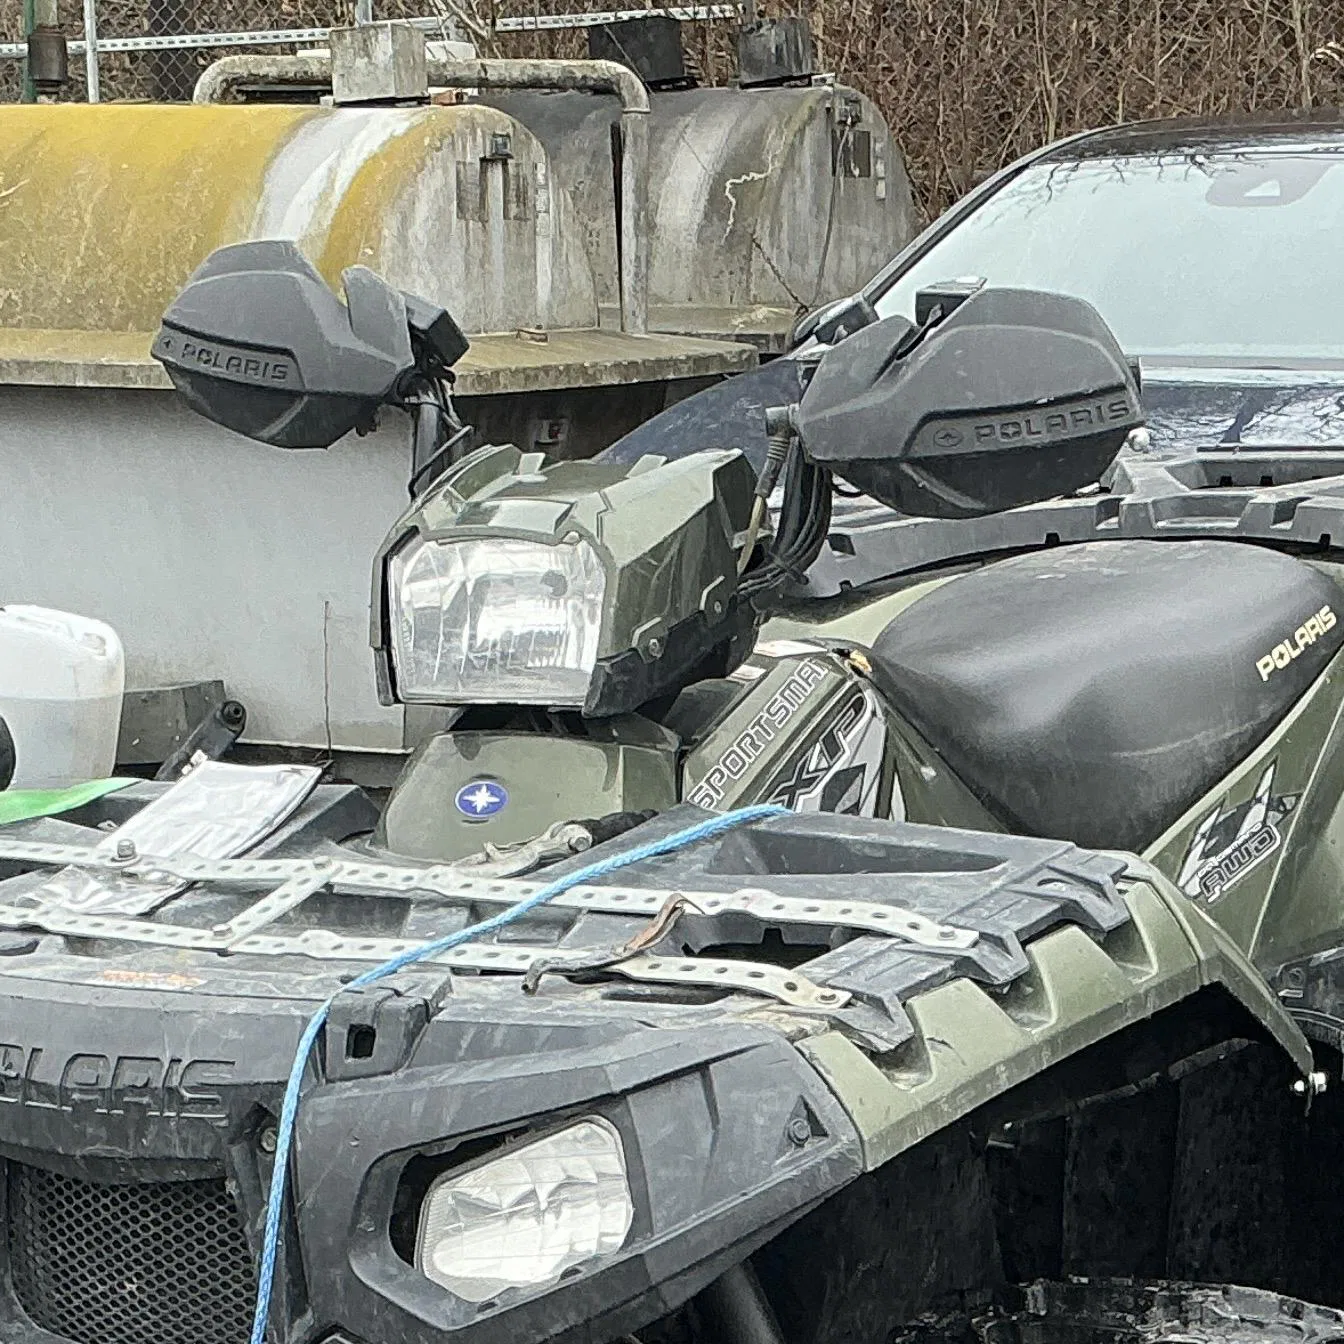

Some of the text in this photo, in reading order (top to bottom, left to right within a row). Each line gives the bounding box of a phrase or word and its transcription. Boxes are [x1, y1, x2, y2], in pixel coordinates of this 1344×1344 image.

[181, 342, 289, 380] POLARIS
[974, 399, 1130, 443] POLARIS
[1255, 604, 1337, 682] POLARIS
[687, 656, 829, 812] SPORTSMA
[1199, 824, 1279, 898] AWD
